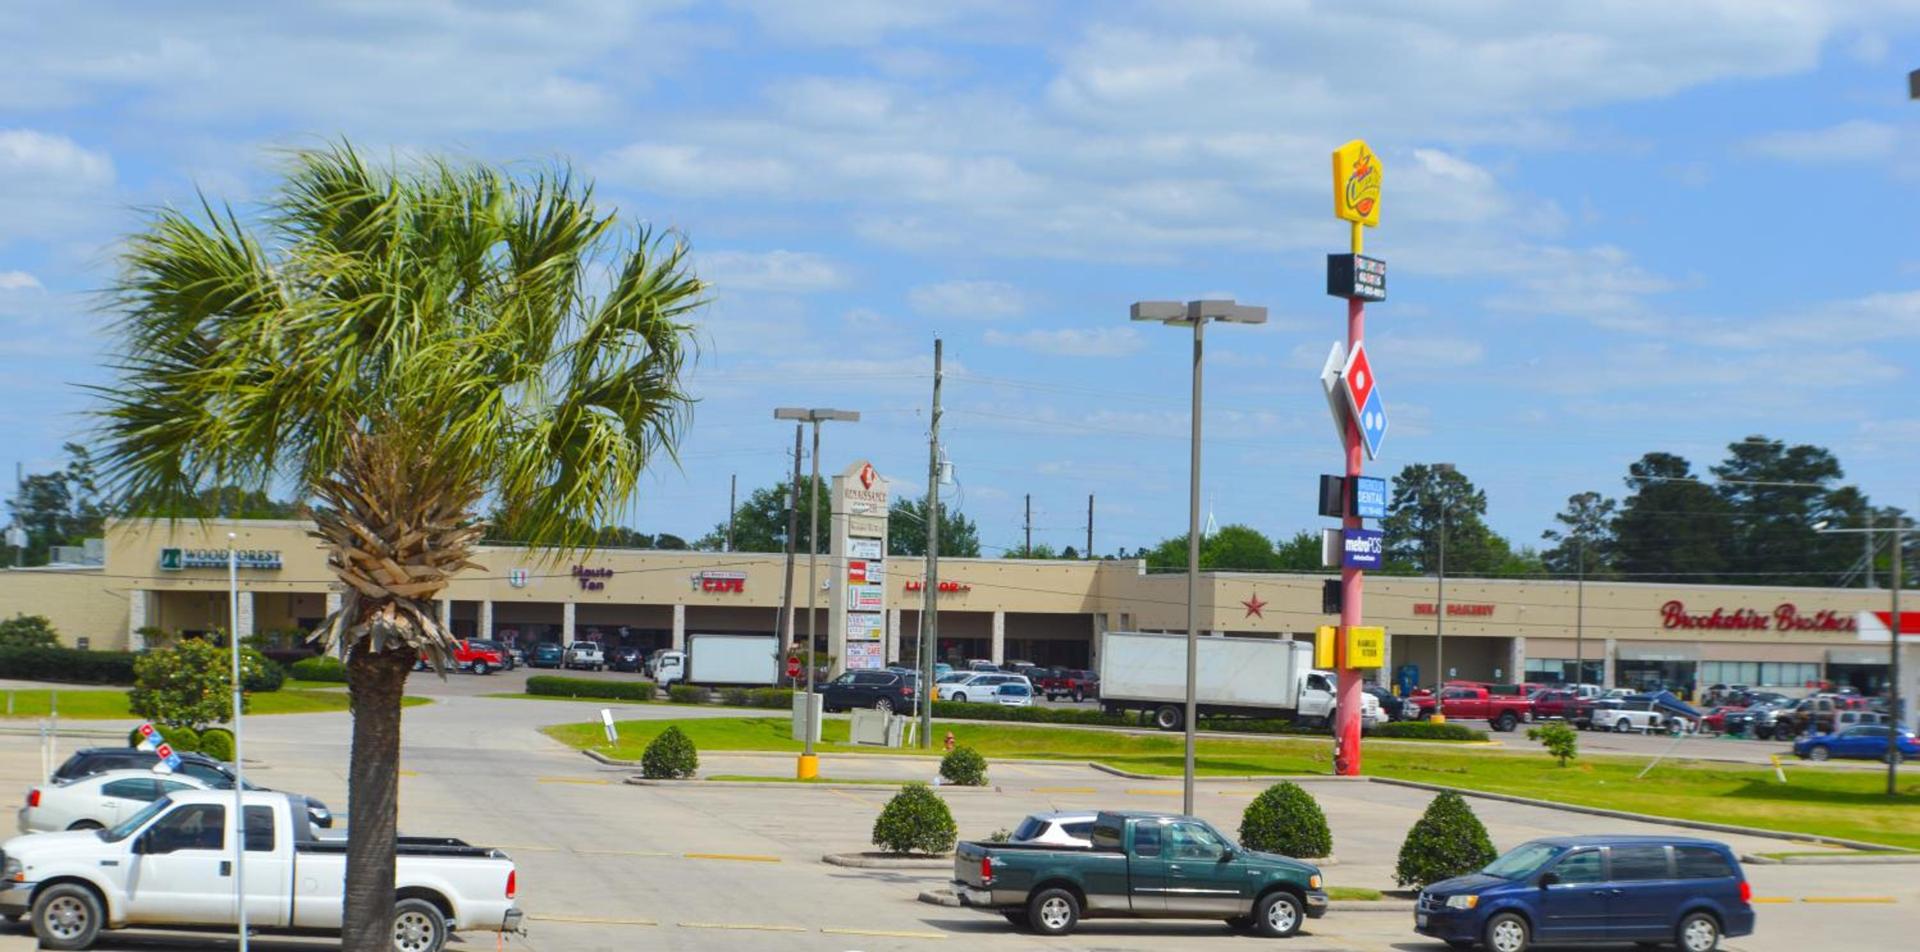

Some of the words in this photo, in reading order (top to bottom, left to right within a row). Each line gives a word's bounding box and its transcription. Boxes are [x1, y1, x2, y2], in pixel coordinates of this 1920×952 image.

[184, 548, 283, 561] WOODOREST
[572, 564, 614, 578] Haute
[579, 578, 604, 590] Tan
[703, 578, 745, 593] CAFE
[905, 581, 959, 592] LIOR
[1660, 600, 1769, 629] Brookshire
